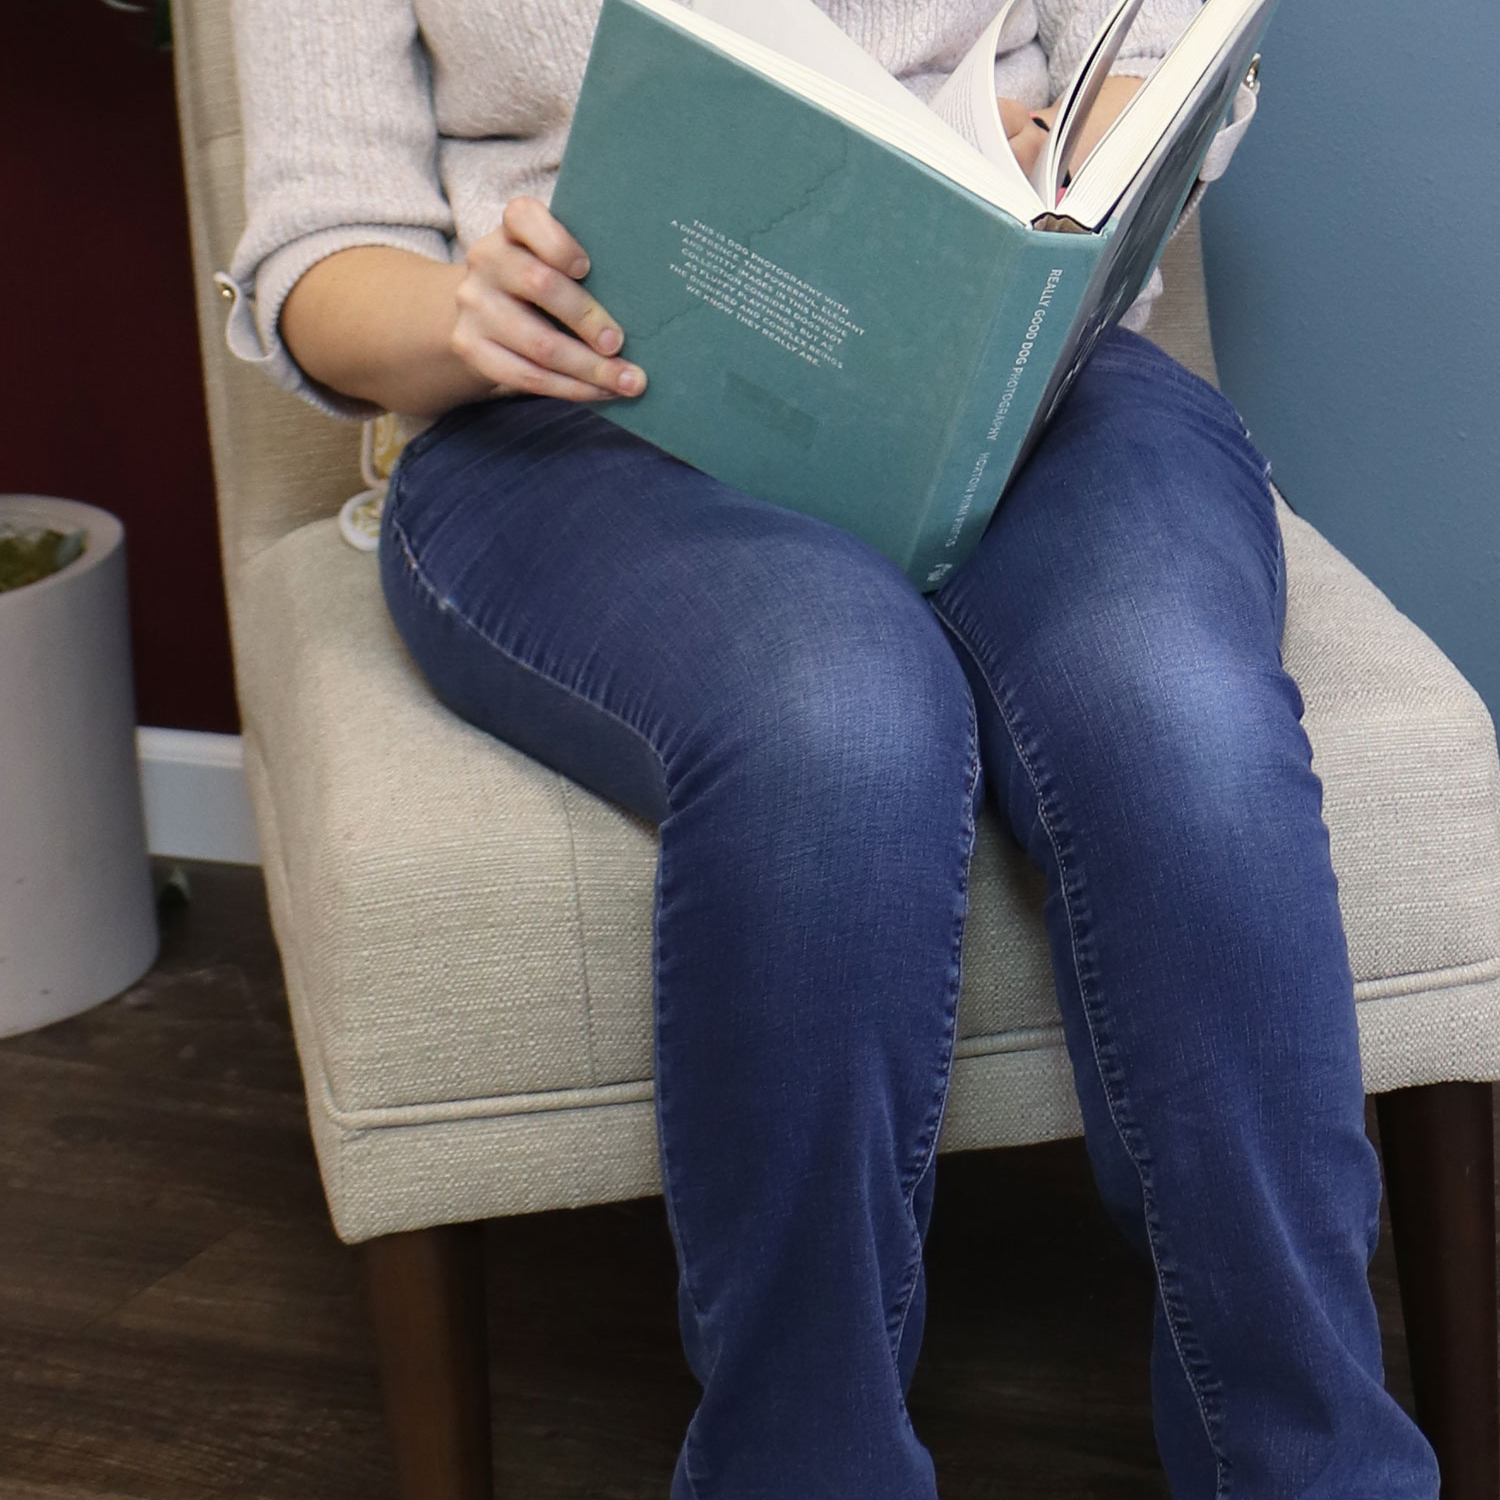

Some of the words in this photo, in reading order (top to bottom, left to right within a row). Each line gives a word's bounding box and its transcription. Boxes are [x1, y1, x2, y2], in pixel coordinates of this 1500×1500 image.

[669, 218, 678, 227] A
[742, 258, 762, 275] THE
[820, 304, 865, 336] ELEGANT
[680, 236, 704, 251] AND
[705, 249, 737, 270] WITTY
[737, 268, 773, 292] IMAGES
[774, 290, 786, 301] IN
[788, 296, 809, 314] THIS
[810, 310, 846, 337] UNIQUE
[680, 246, 742, 286] COLLECTION
[742, 282, 792, 315] CONSIDER
[792, 311, 820, 332] DOGS
[821, 328, 843, 345] NOT
[683, 260, 698, 272] AS
[698, 268, 736, 293] FLUFFY
[798, 326, 819, 342] BUT
[819, 340, 833, 352] AS
[692, 218, 714, 235] THIS
[715, 232, 725, 242] IS
[726, 238, 749, 256] DOG
[749, 251, 822, 298] PHOTOGRAPHY
[823, 294, 849, 315] WITH
[1037, 268, 1063, 307] REALLY
[668, 262, 687, 277] THE
[688, 273, 738, 306] DIGNIFIED
[738, 303, 761, 319] AND
[761, 316, 807, 347] COMPLEX
[807, 343, 843, 369] BEINGS
[685, 282, 701, 296] WE
[702, 293, 734, 315] KNOW
[735, 311, 761, 330] THEY
[760, 326, 798, 352] REALLY
[1014, 341, 1034, 365] DOG
[1024, 308, 1046, 340] GOOD
[985, 362, 1024, 441] PHOTOGRAPHY
